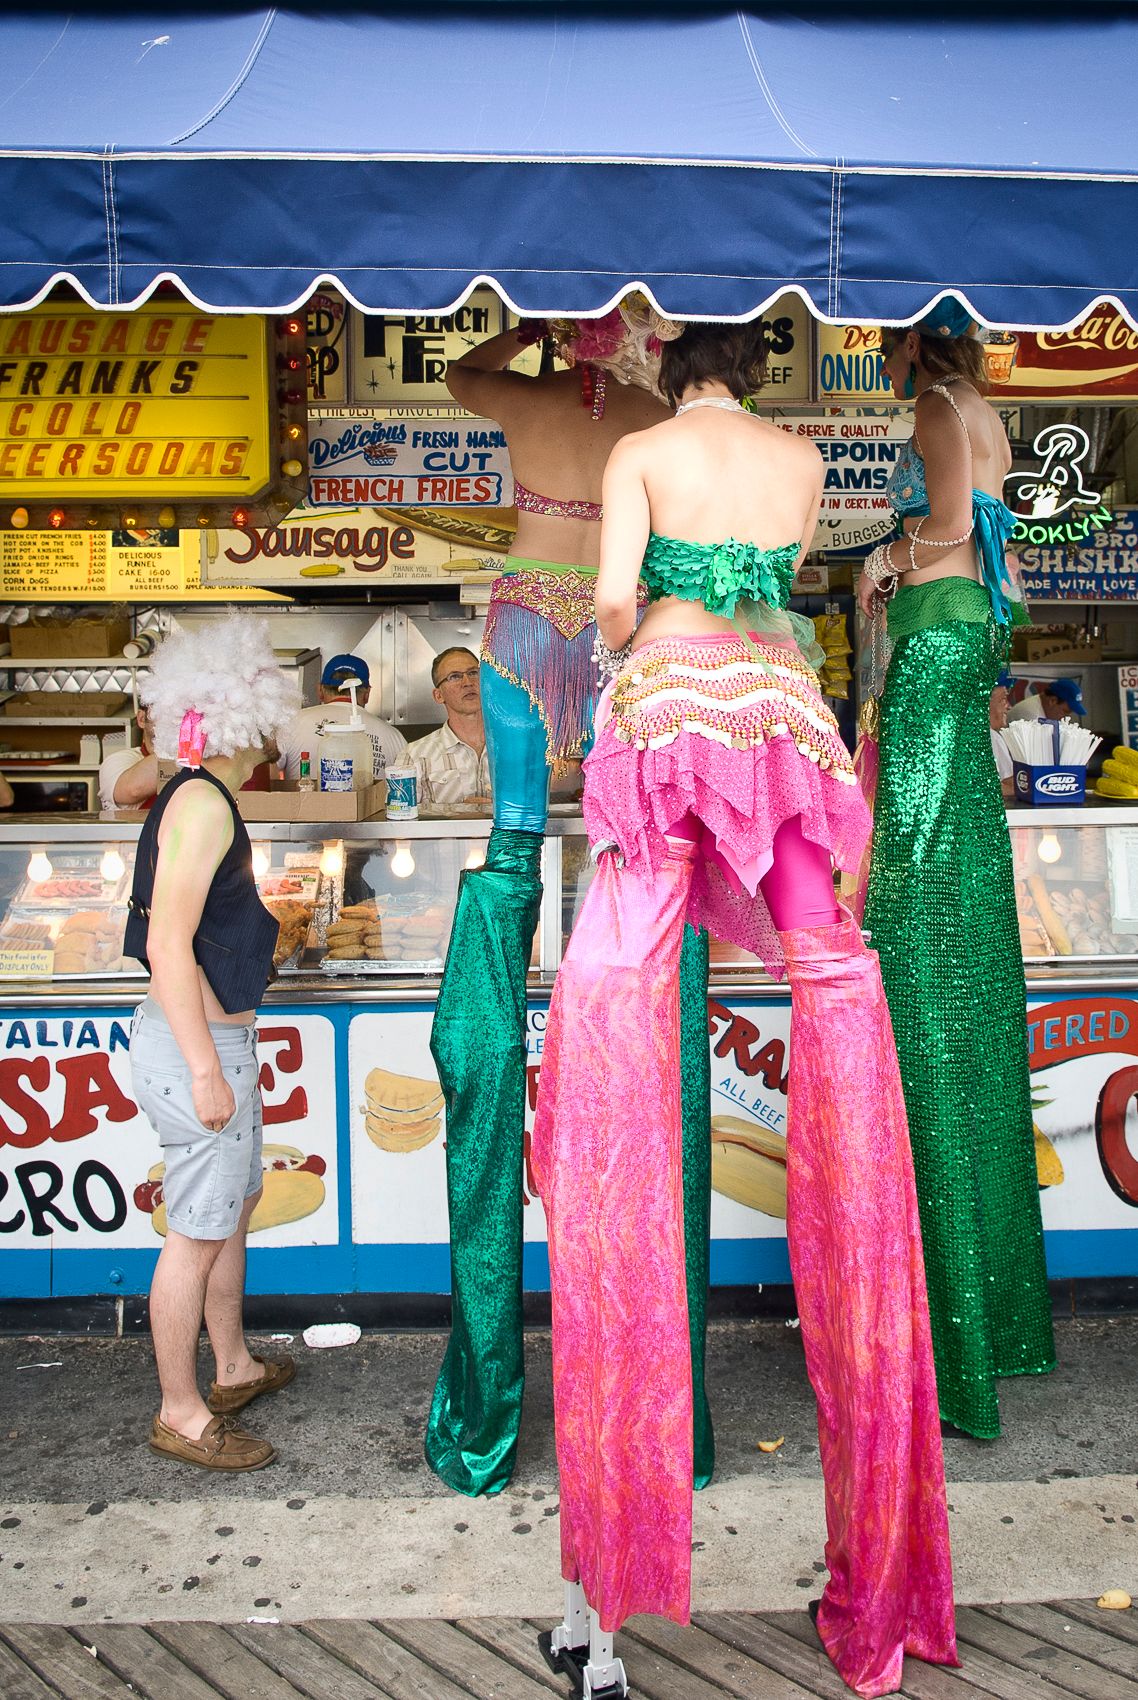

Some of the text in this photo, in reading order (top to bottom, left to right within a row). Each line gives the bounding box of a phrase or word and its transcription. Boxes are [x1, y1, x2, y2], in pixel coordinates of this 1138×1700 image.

[4, 318, 214, 354] AUSAGE
[0, 360, 199, 396] FRANKS
[8, 401, 142, 436] COLD
[797, 424, 836, 437] SERVE
[840, 424, 889, 438] QUALITY
[309, 422, 407, 465] Delicious
[411, 431, 459, 449] FRESH
[423, 452, 493, 472] CUT
[313, 476, 492, 503] FRENCH FRIES
[828, 498, 840, 509] IN
[224, 526, 415, 573] Sausage
[1058, 579, 1096, 591] WITH
[1103, 579, 1136, 591] LOVE
[1043, 783, 1079, 792] LIGHT
[1048, 776, 1076, 784] BUD
[0, 962, 49, 971] DISPLAY ONLY
[0, 1020, 130, 1053] ALIAN
[720, 1077, 785, 1126] ALL BEEF
